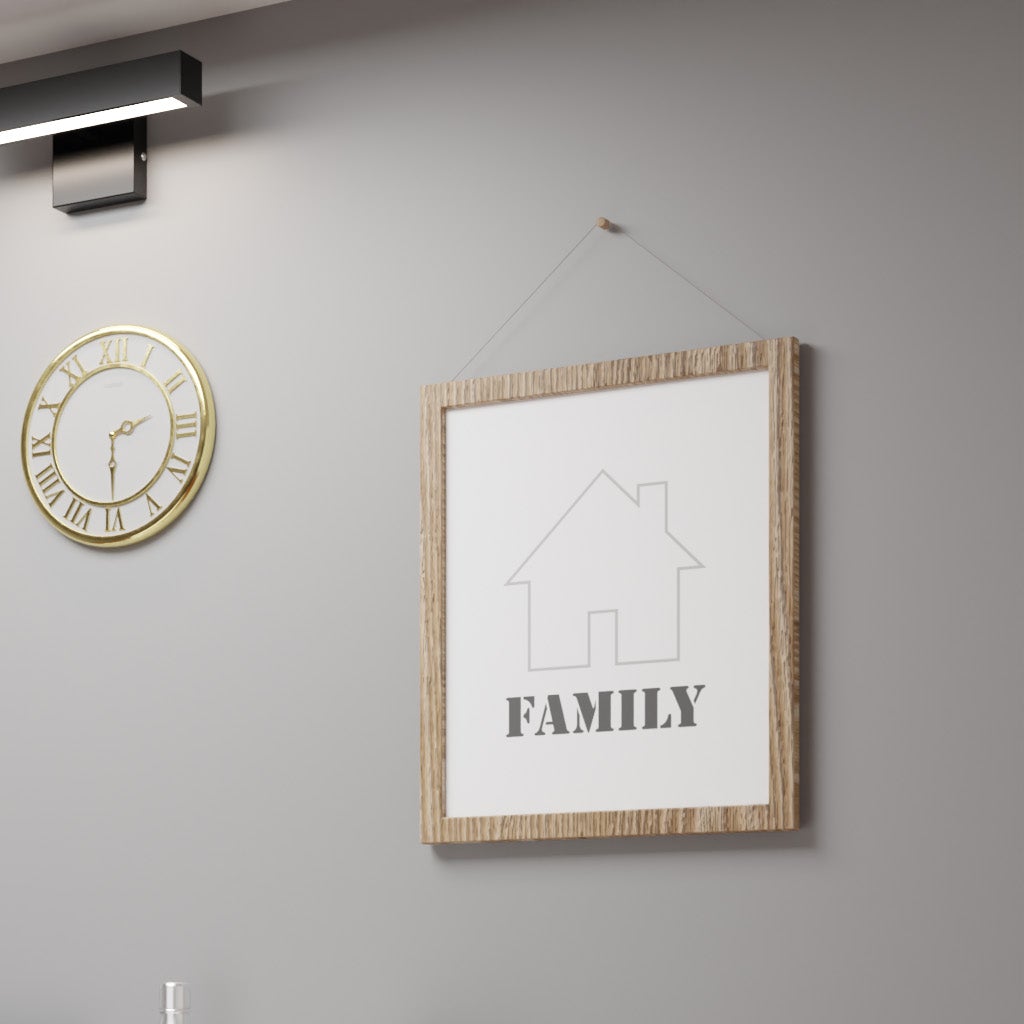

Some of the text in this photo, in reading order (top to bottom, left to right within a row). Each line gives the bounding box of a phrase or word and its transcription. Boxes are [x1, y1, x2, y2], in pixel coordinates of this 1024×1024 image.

[99, 337, 128, 365] XII
[141, 343, 155, 367] I
[59, 354, 87, 388] XI
[163, 368, 187, 394] II
[38, 397, 60, 418] X
[176, 411, 198, 440] III
[31, 432, 51, 457] IX
[166, 453, 191, 484] IV
[35, 463, 63, 508] VIII
[63, 497, 92, 531] VII
[145, 492, 162, 516] V
[104, 507, 126, 532] VI
[506, 685, 705, 737] FAMILY
